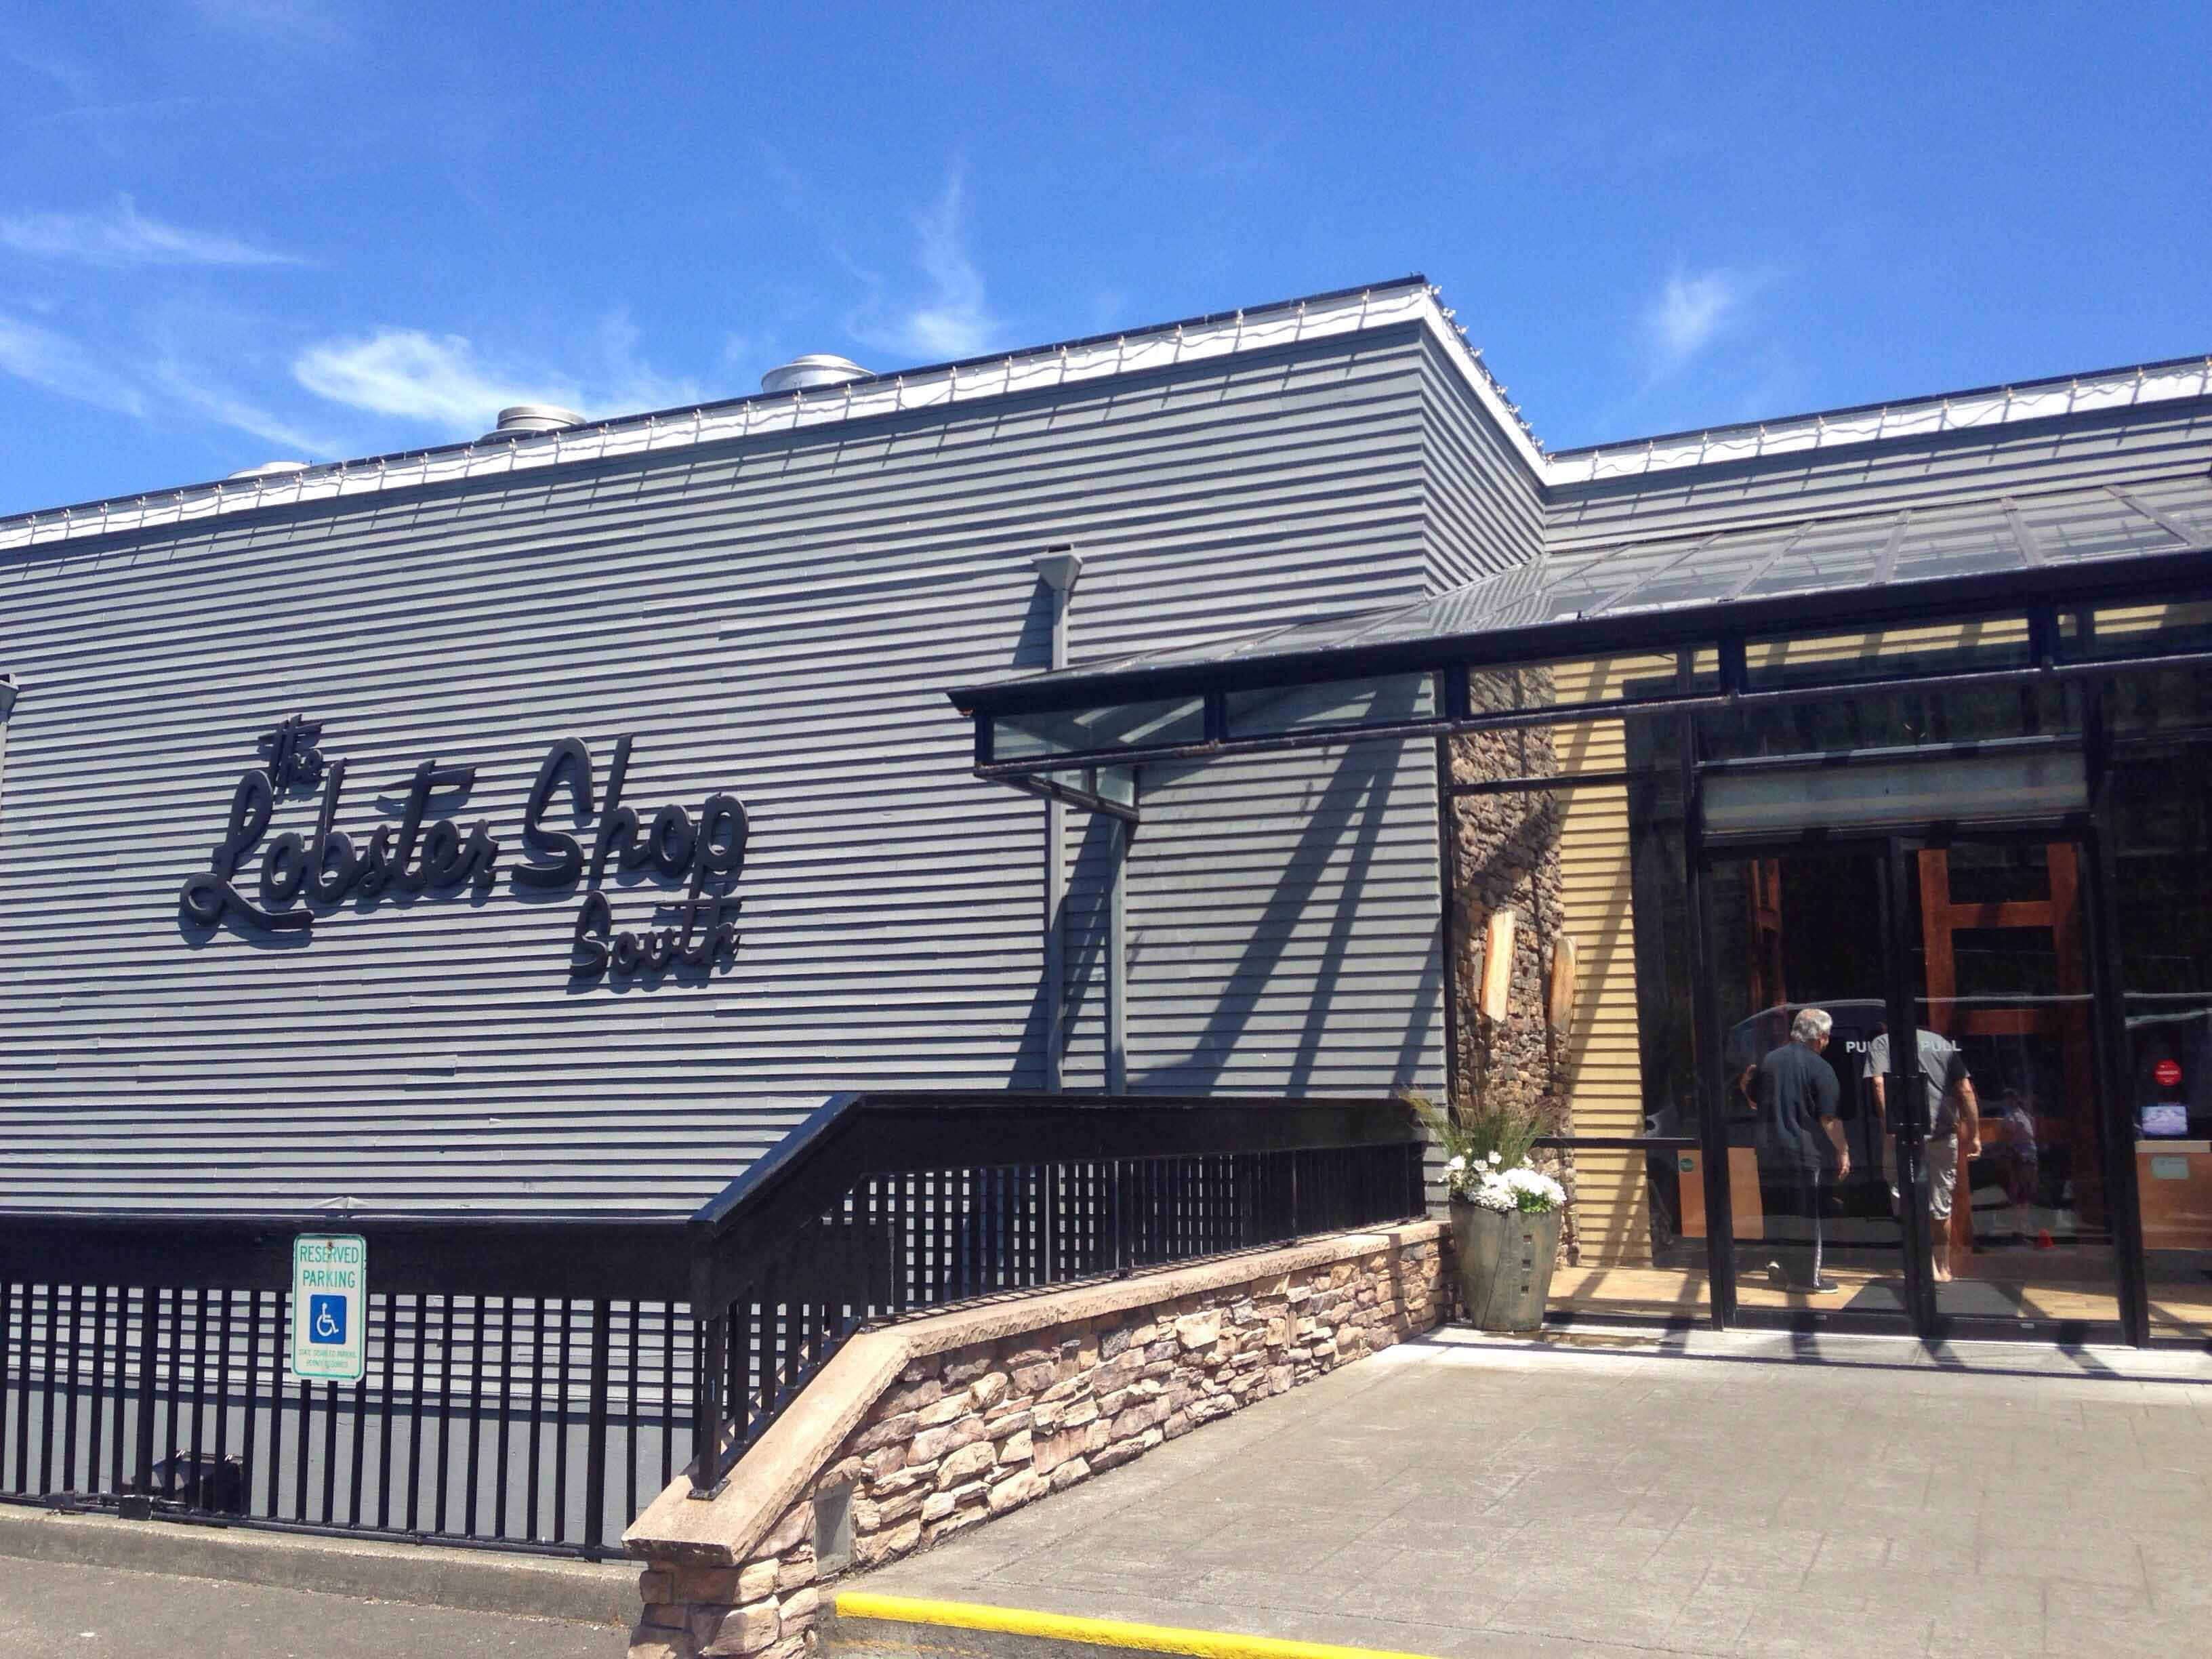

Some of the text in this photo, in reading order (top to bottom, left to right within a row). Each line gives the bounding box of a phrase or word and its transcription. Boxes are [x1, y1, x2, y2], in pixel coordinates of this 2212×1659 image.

[180, 733, 749, 930] Lobster Shop
[569, 882, 742, 977] South
[1921, 1040, 1963, 1052] PULL
[300, 1246, 359, 1264] RESERVED
[303, 1269, 356, 1288] PARKING
